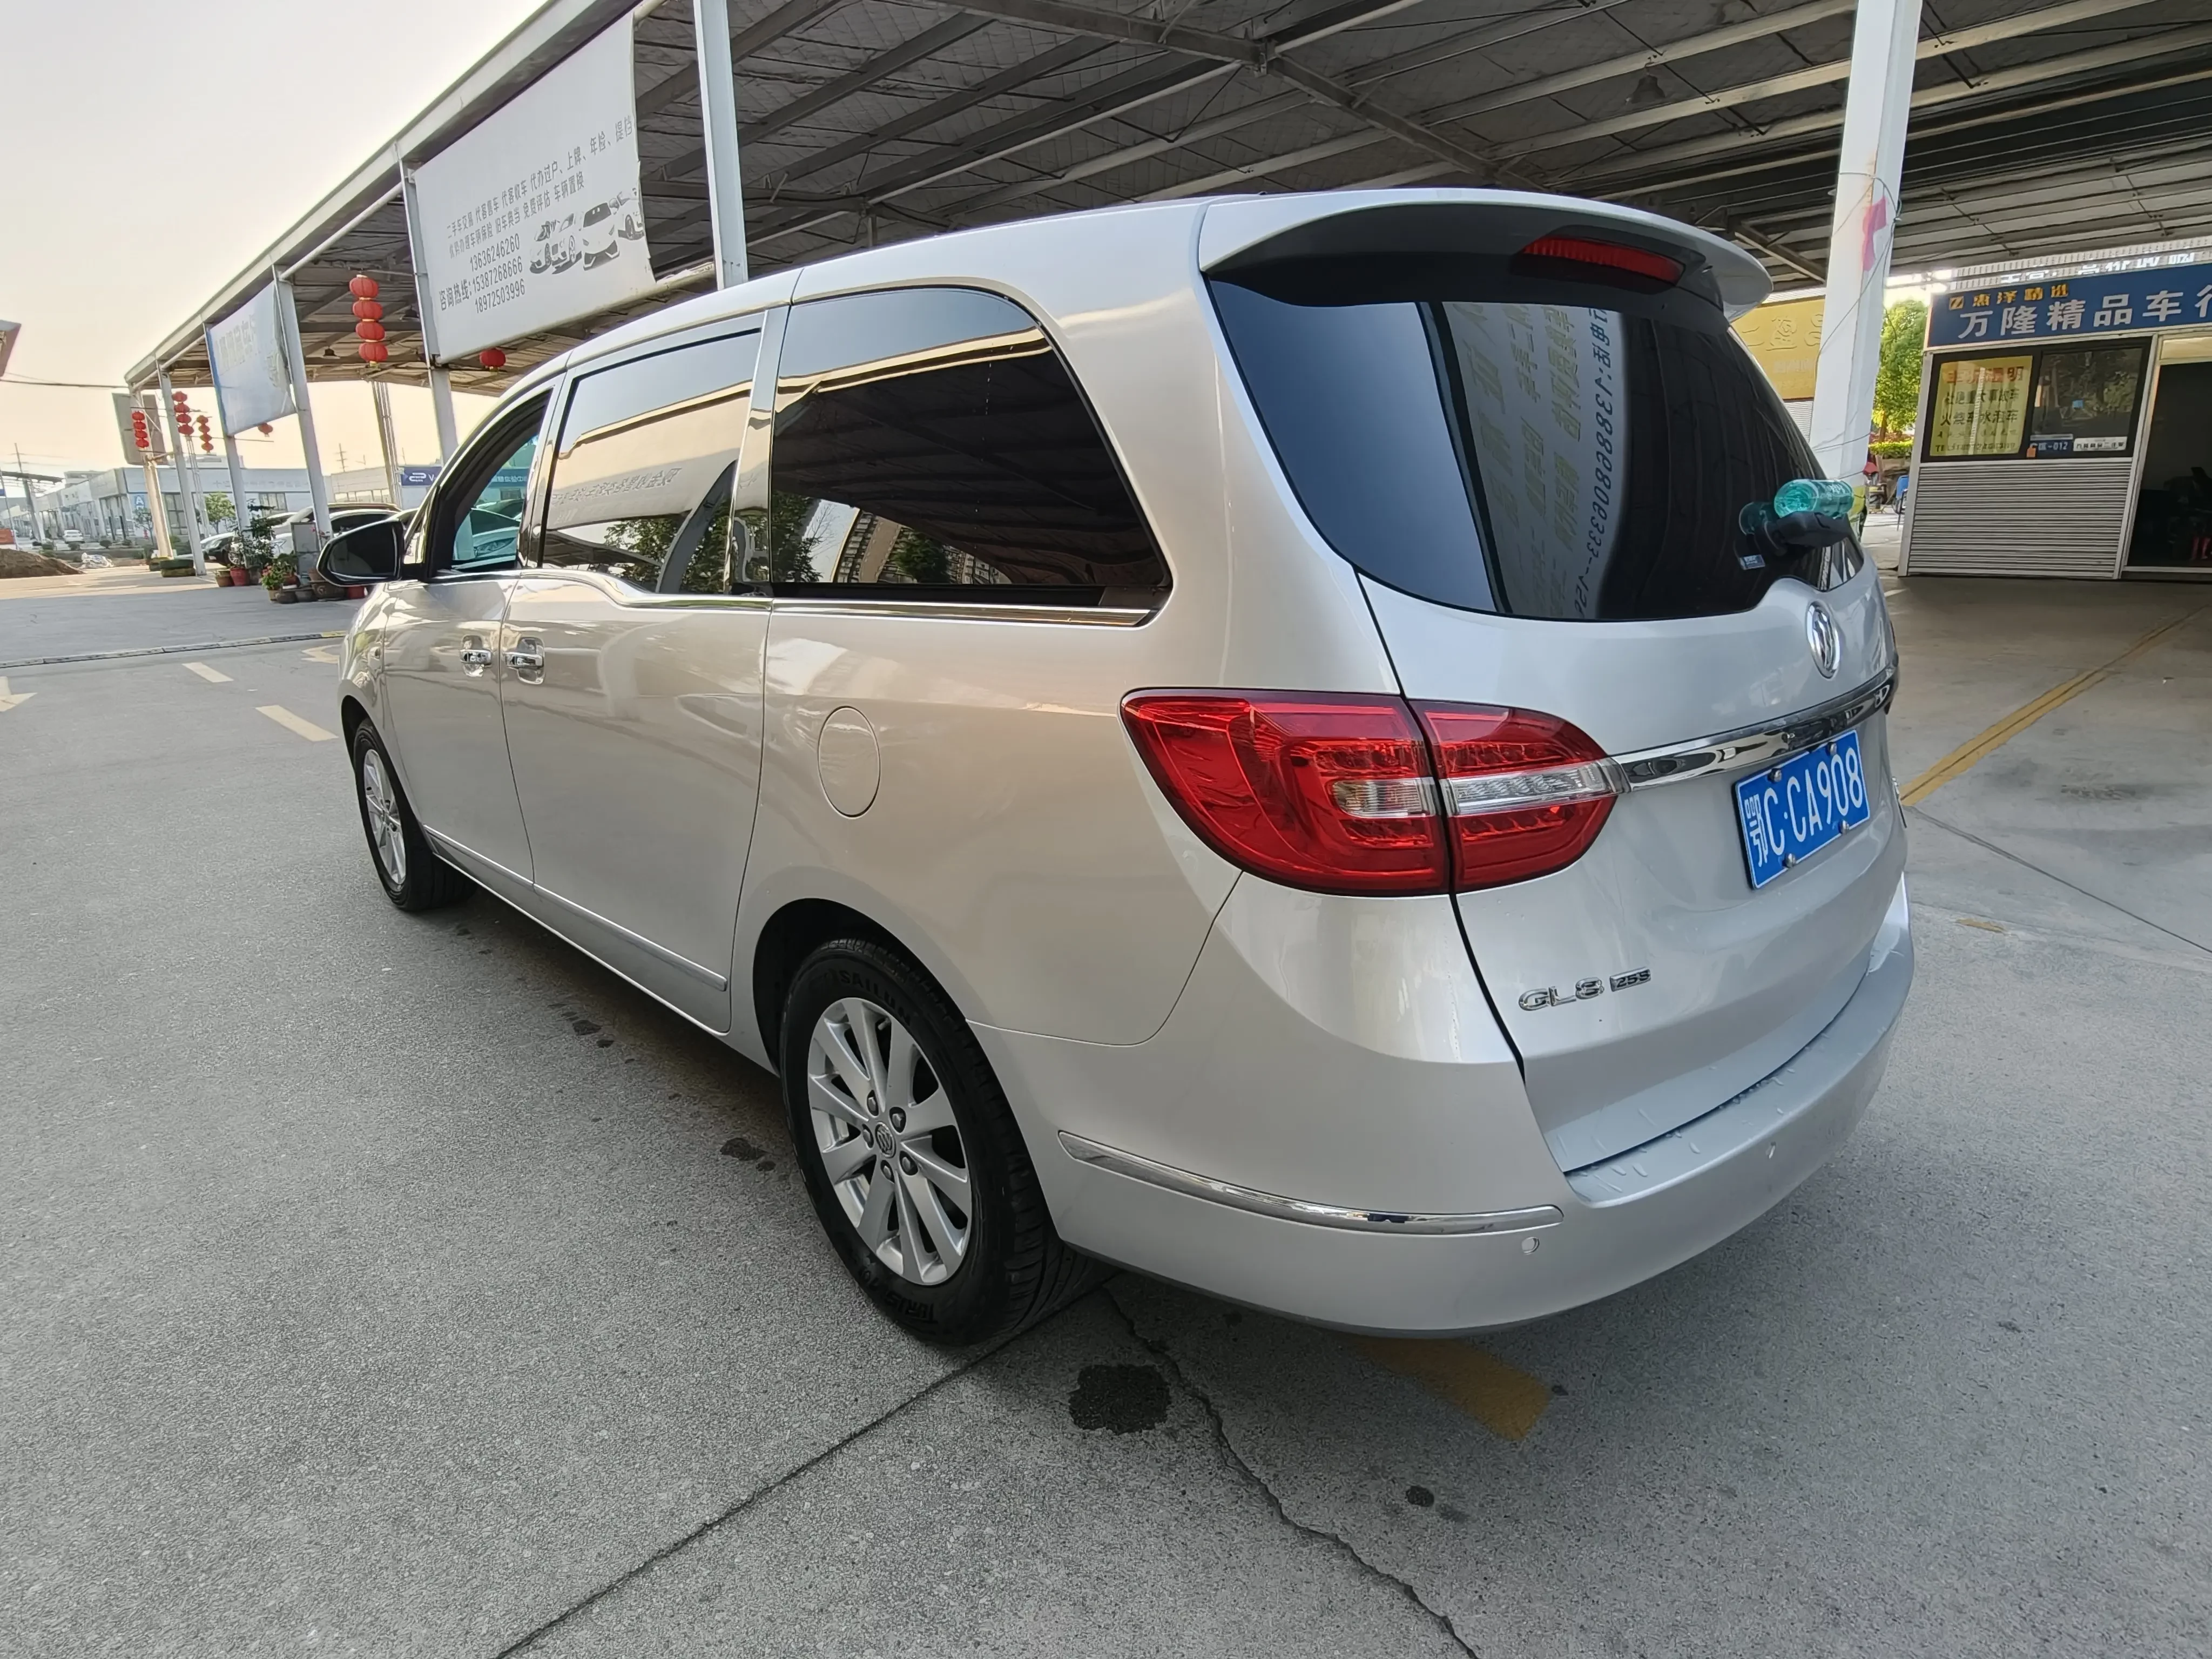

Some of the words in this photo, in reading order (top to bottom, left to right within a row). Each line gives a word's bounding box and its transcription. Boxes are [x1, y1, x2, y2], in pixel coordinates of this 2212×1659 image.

[446, 212, 474, 239] 二手车交易
[502, 179, 528, 208] 代客收车
[523, 190, 550, 220] 免费评估
[553, 171, 584, 202] 车辆置换
[469, 233, 520, 272] 13636246260
[475, 278, 525, 314] 18972503996
[1744, 747, 1863, 867] 鄂C·CA908
[838, 969, 911, 1026] SAILUN
[1518, 976, 1605, 1011] GL8
